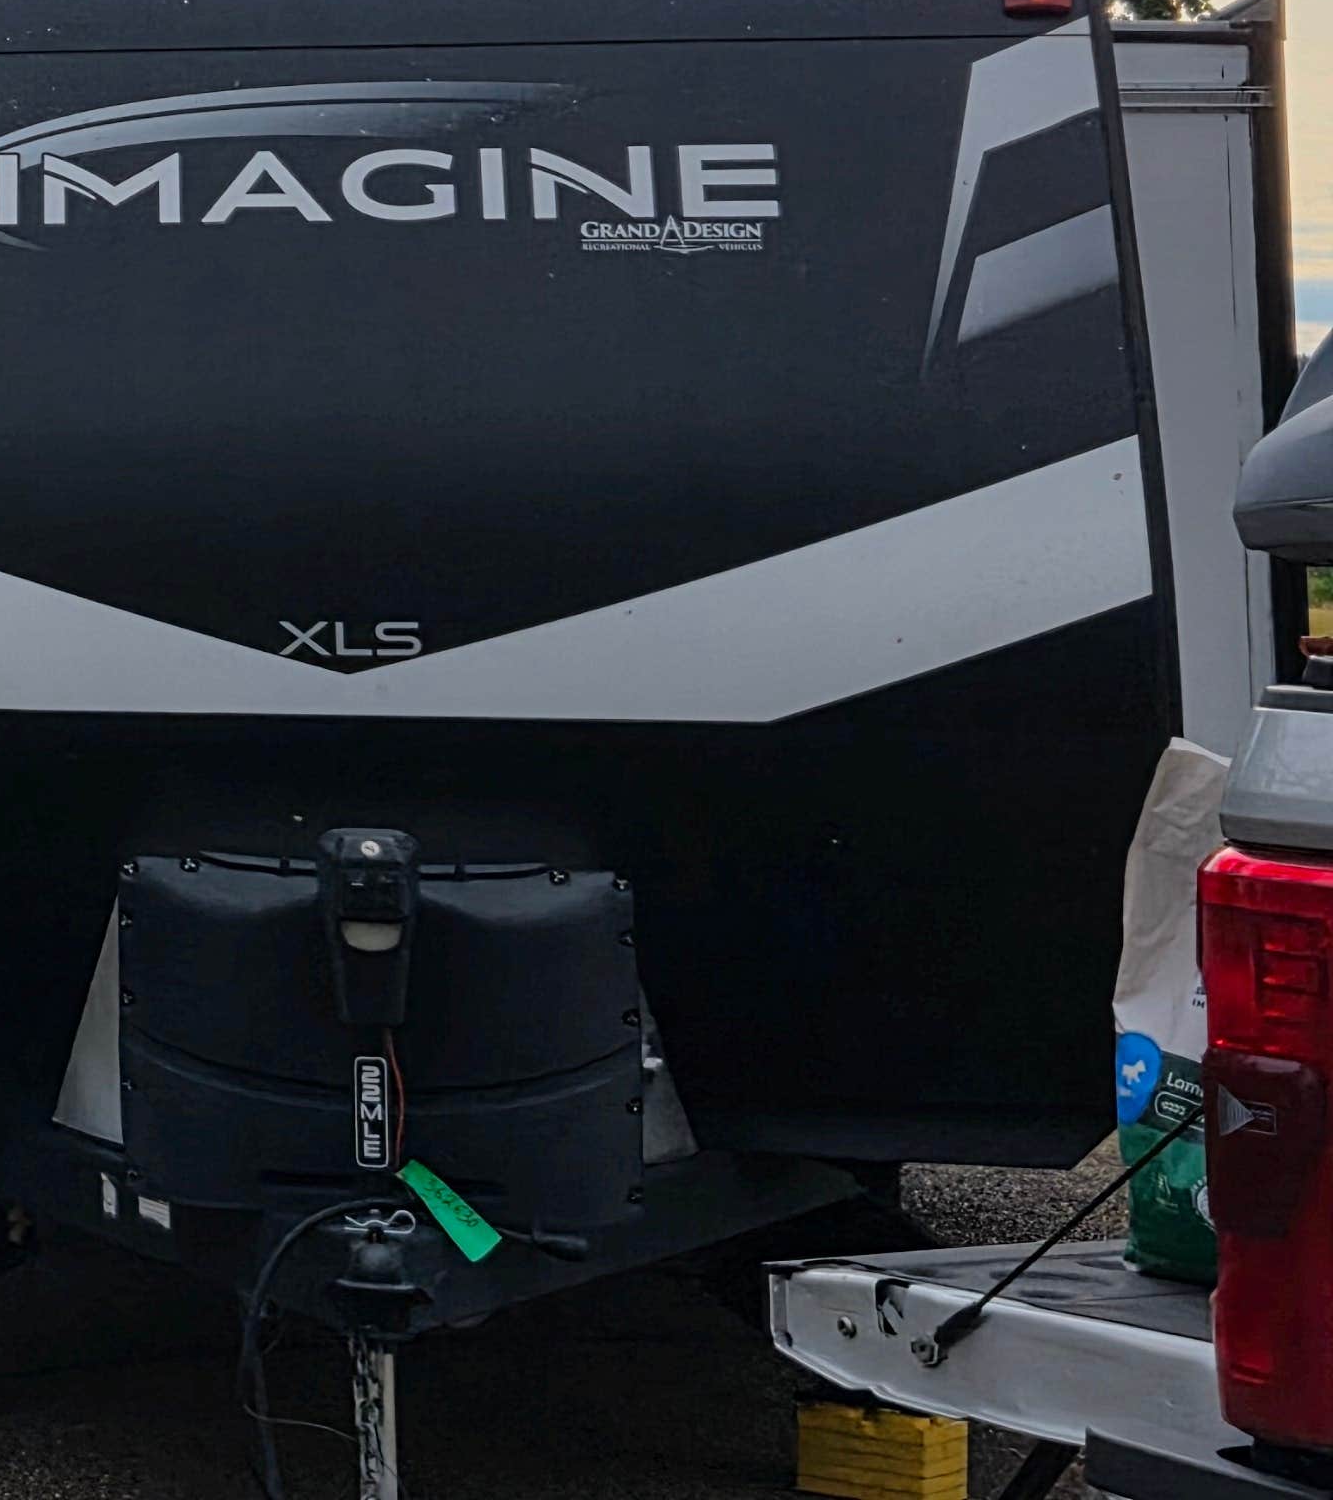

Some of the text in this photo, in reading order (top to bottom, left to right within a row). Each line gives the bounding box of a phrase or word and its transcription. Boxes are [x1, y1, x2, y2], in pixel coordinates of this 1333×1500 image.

[580, 221, 763, 239] GRAND DESIGN
[582, 242, 763, 251] RECREATIONAL VEHICLES
[278, 620, 422, 657] XLS
[1165, 1071, 1204, 1098] Lam
[360, 1064, 383, 1160] 22MLE
